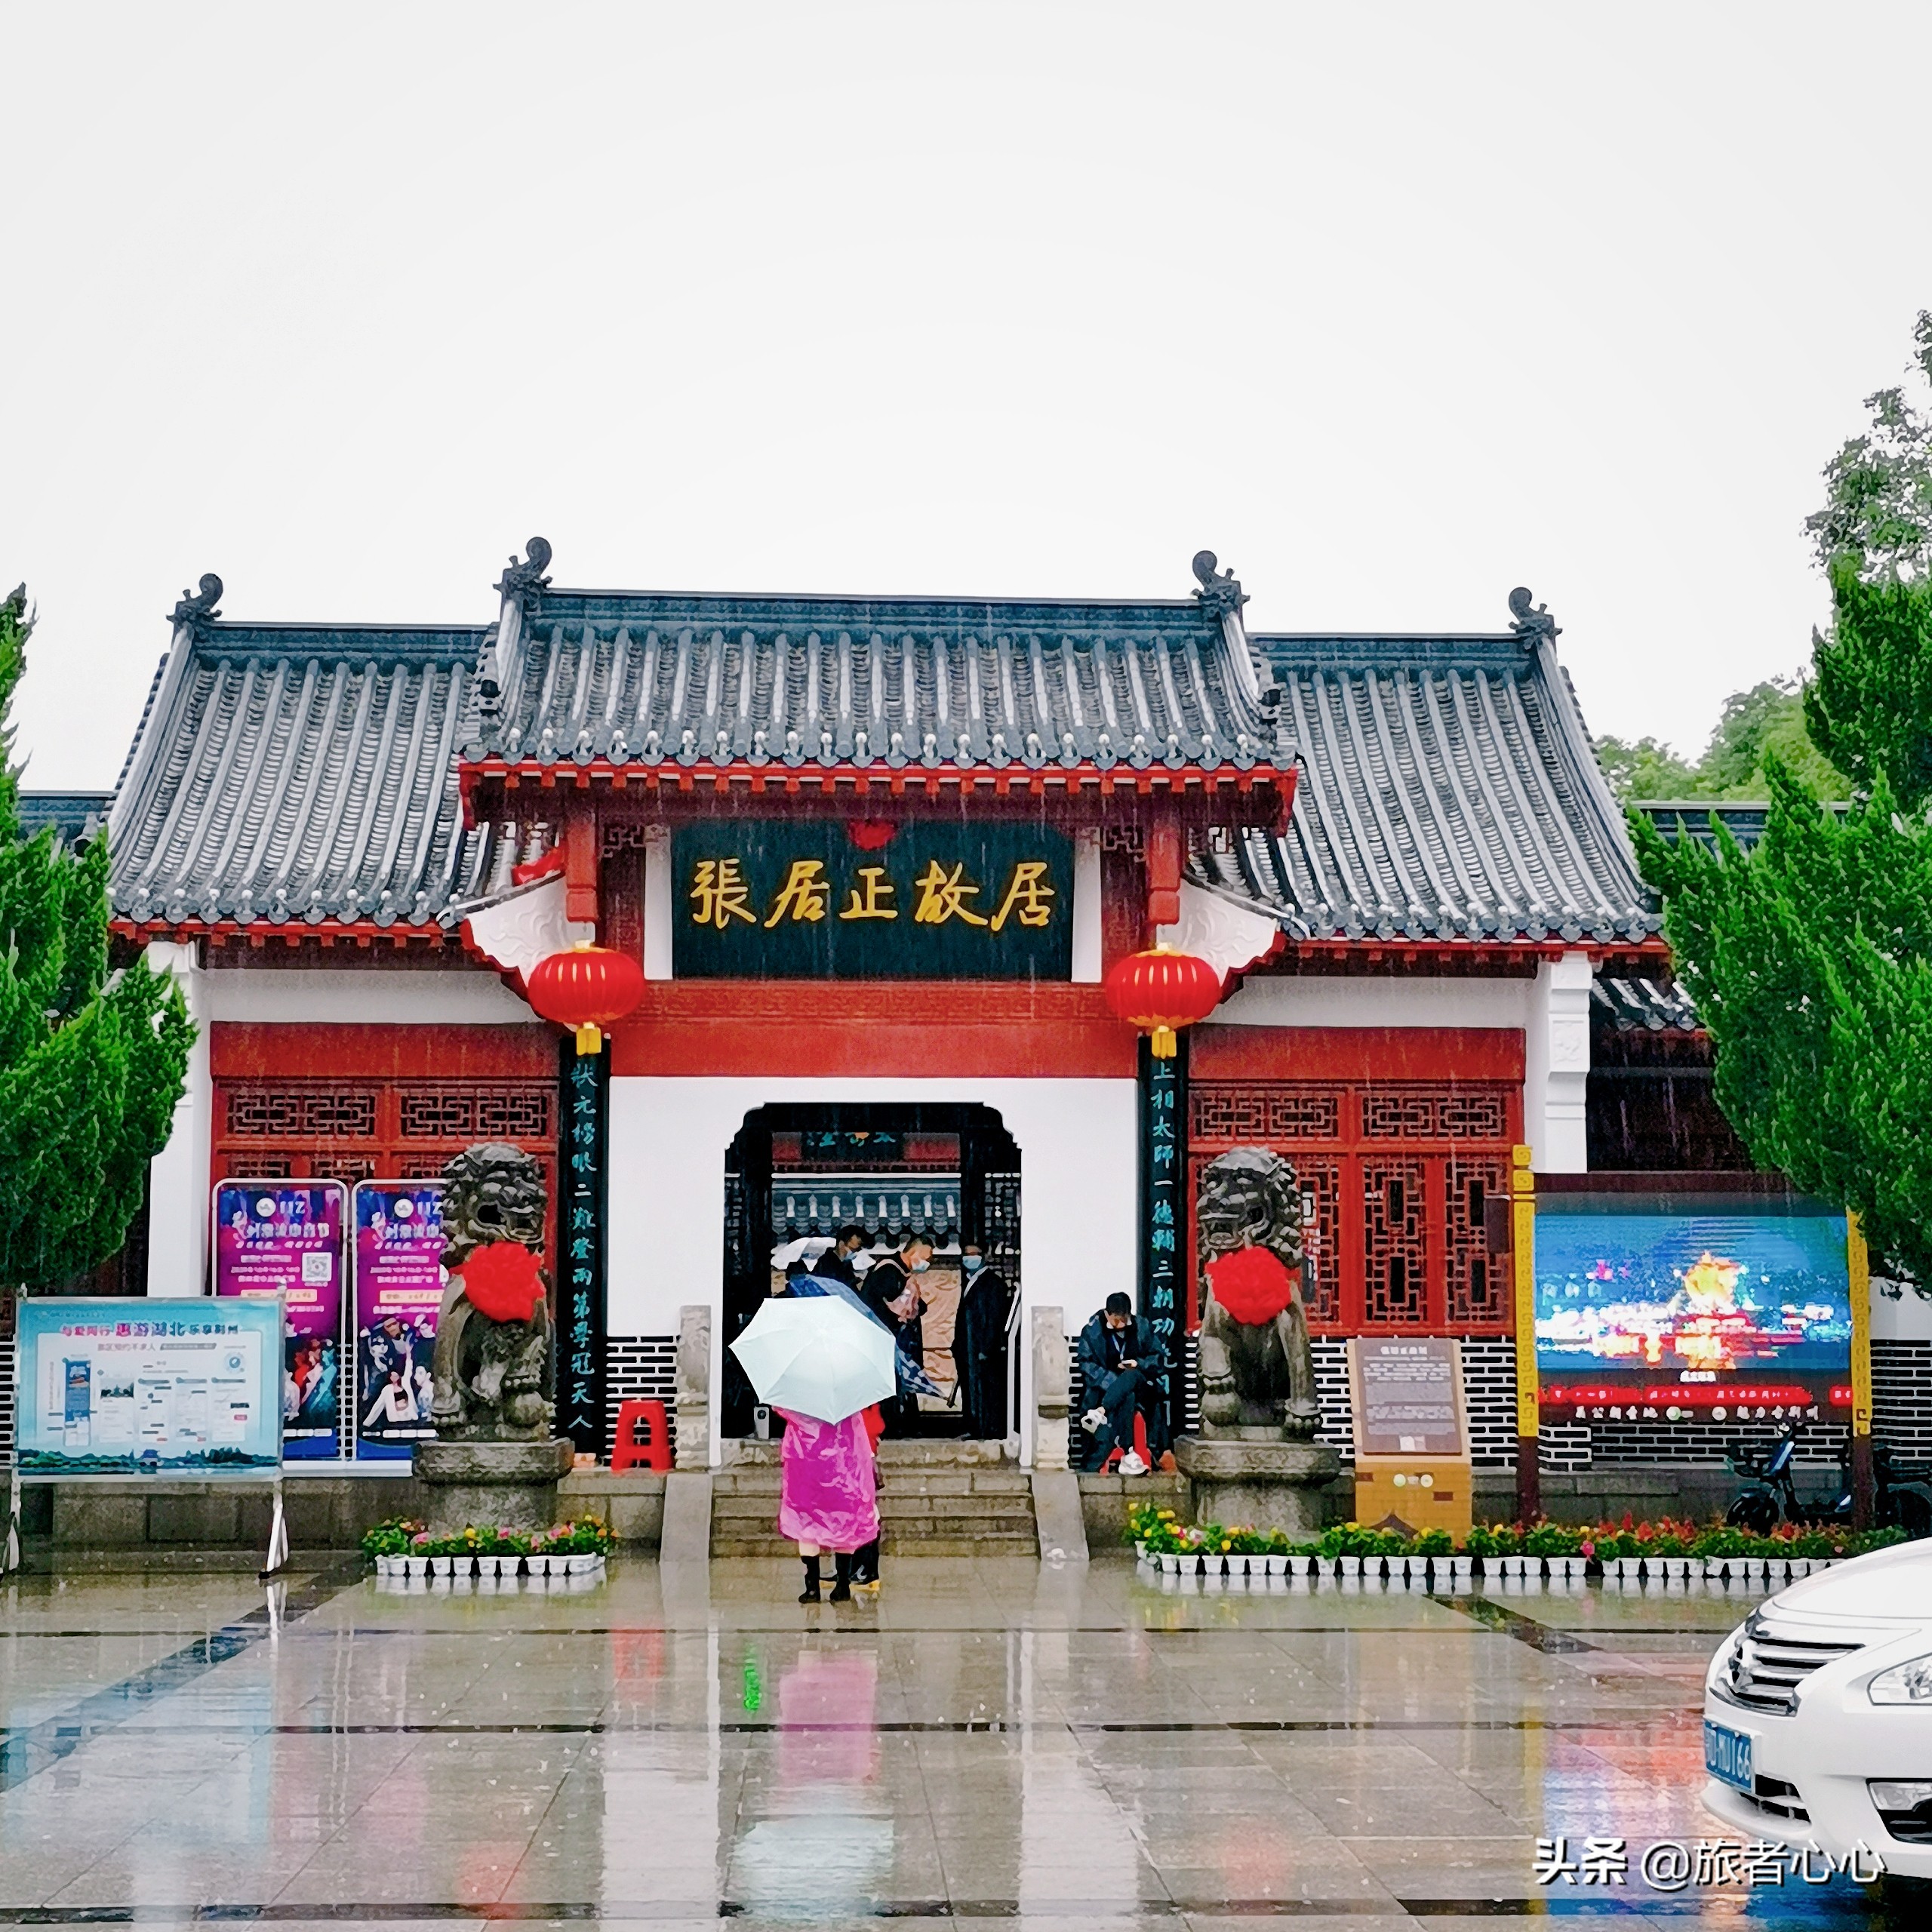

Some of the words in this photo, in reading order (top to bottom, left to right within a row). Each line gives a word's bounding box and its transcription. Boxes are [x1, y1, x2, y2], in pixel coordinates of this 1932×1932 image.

[690, 858, 1055, 931] 張居正故居
